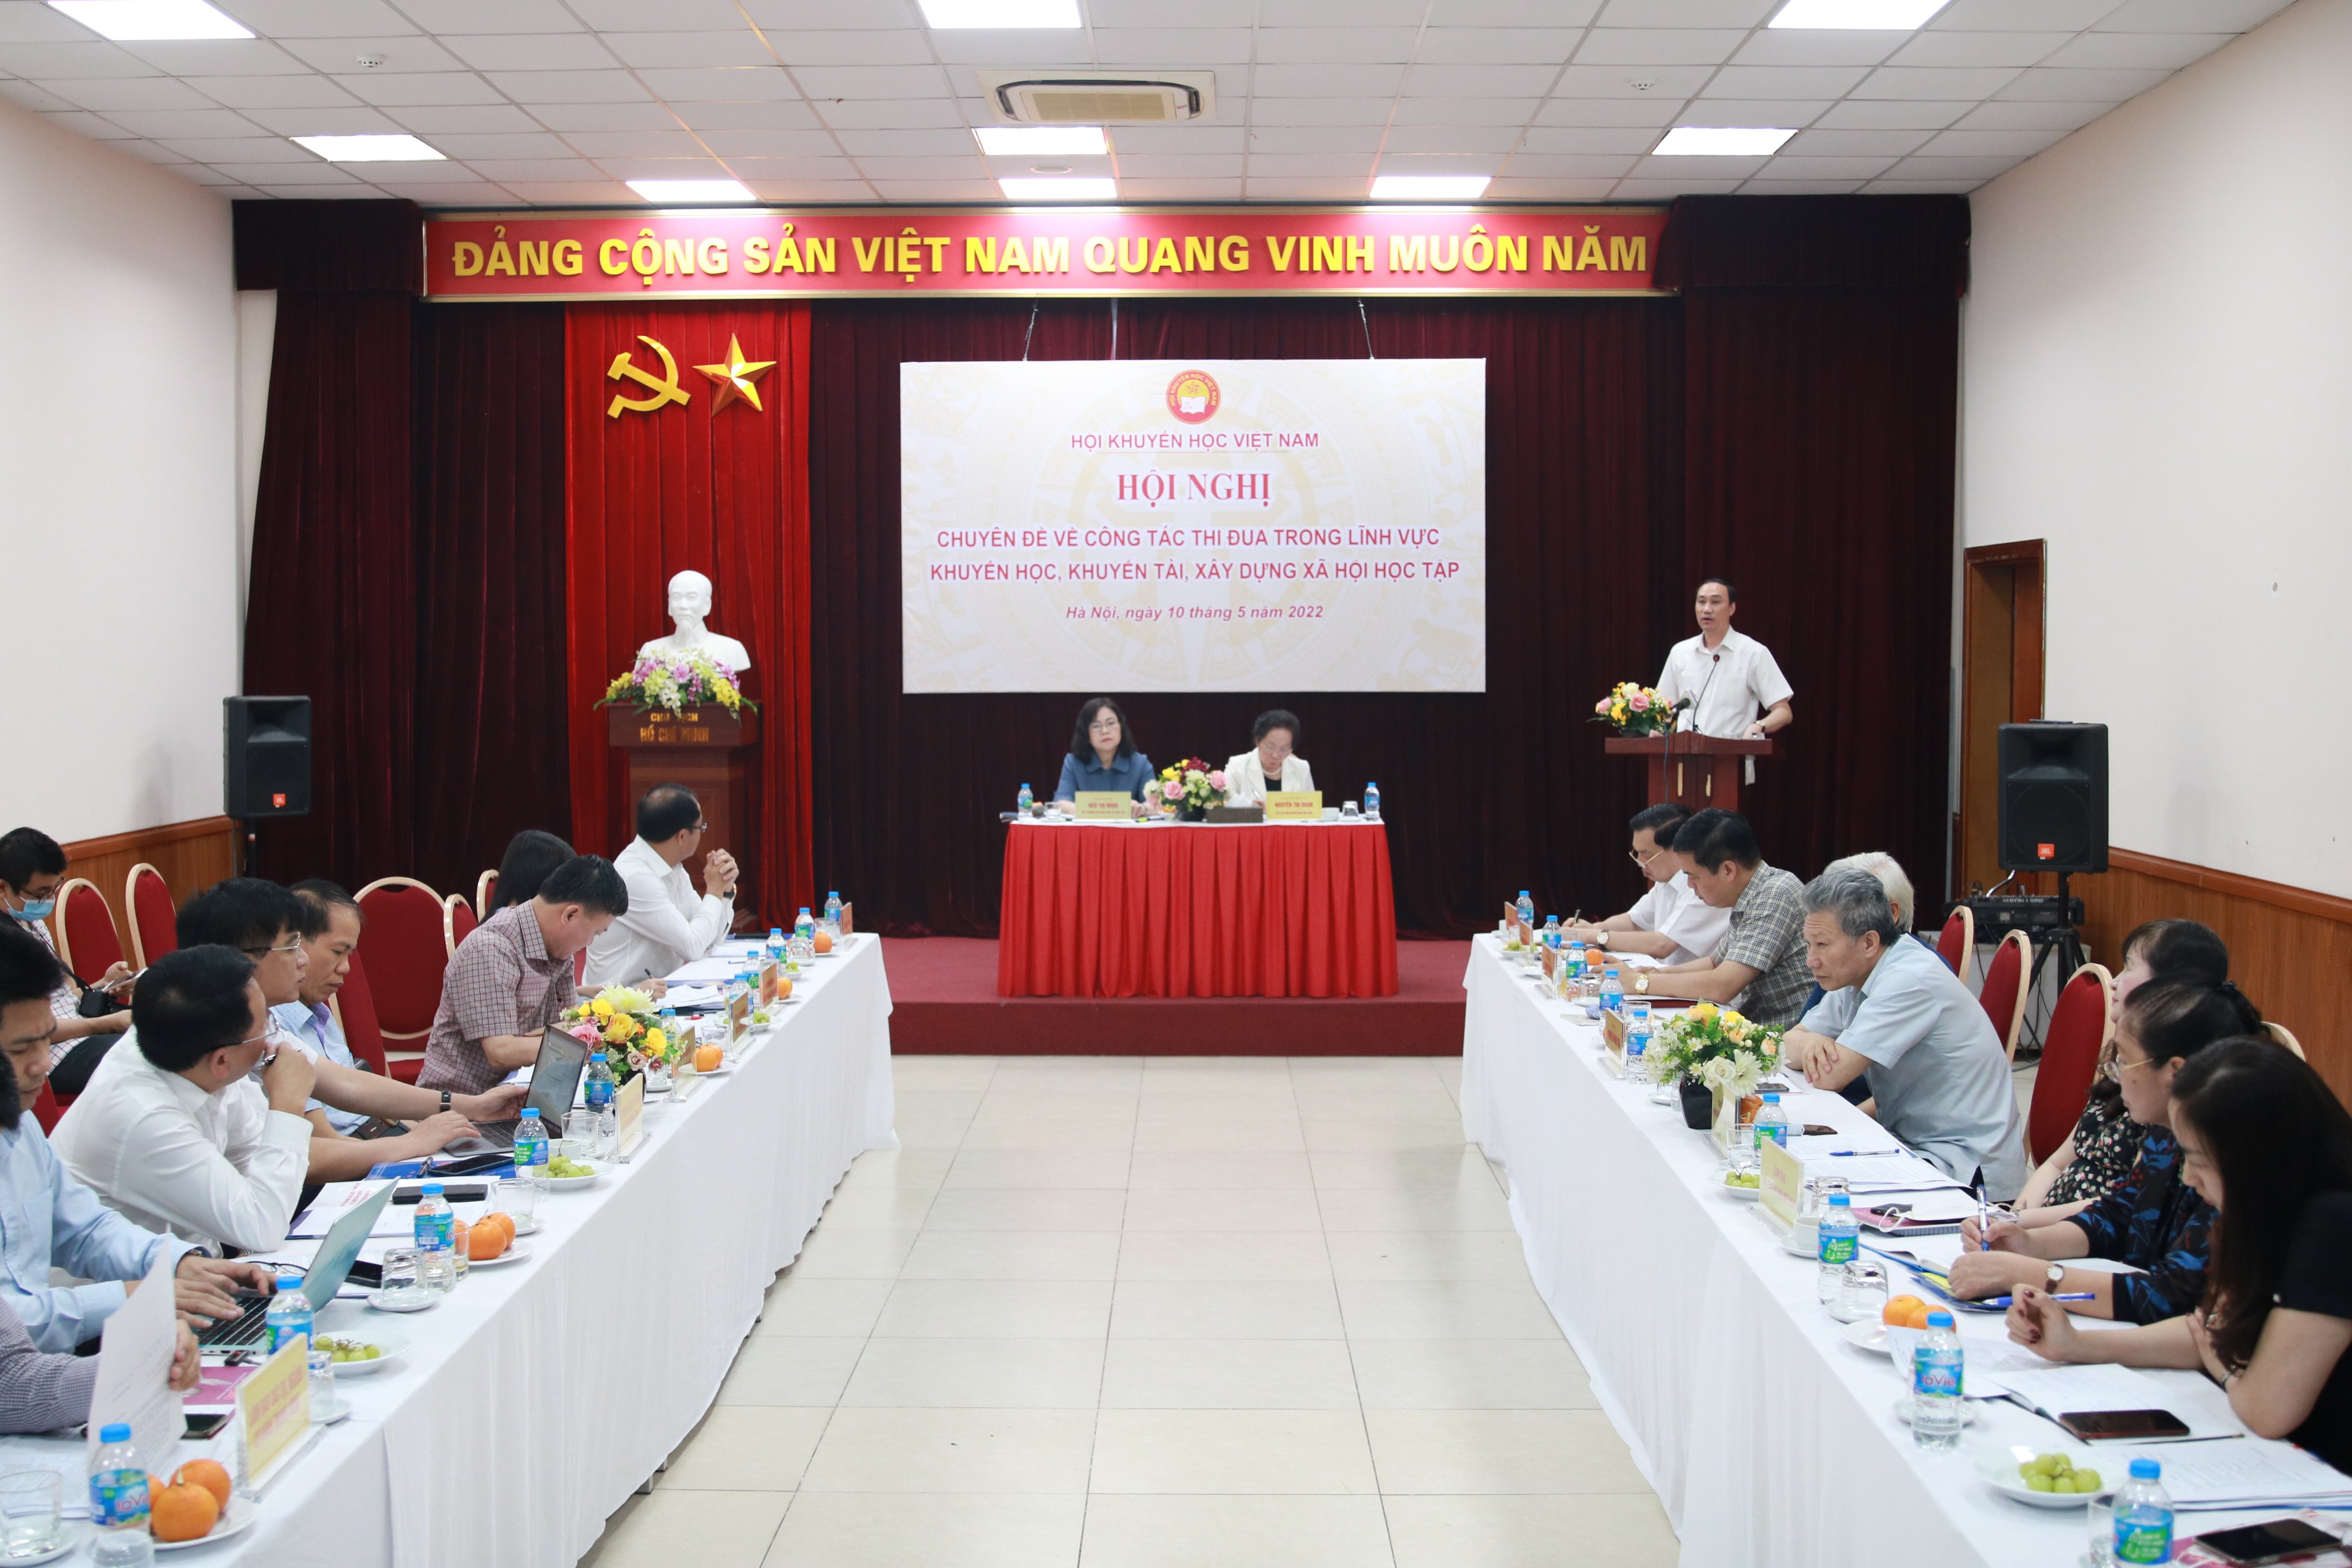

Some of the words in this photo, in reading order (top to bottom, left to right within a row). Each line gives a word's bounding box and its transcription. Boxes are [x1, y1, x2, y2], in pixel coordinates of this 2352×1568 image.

[453, 225, 582, 277] ĐẢNG
[599, 228, 729, 285] CỘNG
[743, 222, 836, 275] SẢN
[852, 227, 951, 283] VIỆT
[965, 235, 1070, 273] NAM
[1082, 234, 1250, 273] QUANG
[1266, 235, 1374, 272] VINH
[1389, 223, 1528, 272] MUÔN
[1542, 225, 1647, 272] NĂM
[1071, 434, 1102, 450] HỘI
[1109, 431, 1183, 449] KHUYẾN
[1189, 433, 1227, 450] HỌC
[1234, 431, 1272, 449] VIỆT
[1279, 433, 1319, 448] NAM
[1117, 469, 1176, 508] HỘI
[1188, 473, 1270, 507] NGHỊ
[937, 527, 1015, 547] CHUYÊN
[1022, 526, 1048, 547] ĐỀ
[1055, 525, 1077, 547] VỀ
[1084, 527, 1140, 547] CÔNG
[1148, 525, 1184, 546] TÁC
[1192, 530, 1221, 546] THI
[1227, 530, 1268, 546] ĐUA
[1274, 528, 1342, 546] TRONG
[1349, 524, 1392, 546] LĨNH
[1398, 528, 1439, 549] VỰC
[931, 558, 1009, 581] KHUYẾN
[1016, 563, 1061, 583] HỌC,
[1069, 558, 1147, 580] KHUYẾN
[1154, 558, 1189, 582] TÀI,
[1195, 560, 1233, 579] XÂY
[1240, 562, 1296, 582] DỰNG
[1304, 558, 1328, 579] XÃ
[1335, 561, 1368, 582] HỘI
[1374, 562, 1415, 582] HỌC
[1423, 559, 1459, 582] TẬP
[1067, 606, 1086, 619] Hà
[1092, 606, 1120, 621] Nội,
[1126, 607, 1163, 621] ngày
[1168, 607, 1185, 619] 10
[1189, 606, 1232, 621] tháng
[1238, 606, 1246, 618] 5
[1250, 607, 1283, 619] năm
[1288, 605, 1323, 619] 2022
[678, 712, 698, 723] ỊCH
[1922, 1373, 1956, 1386] laVie
